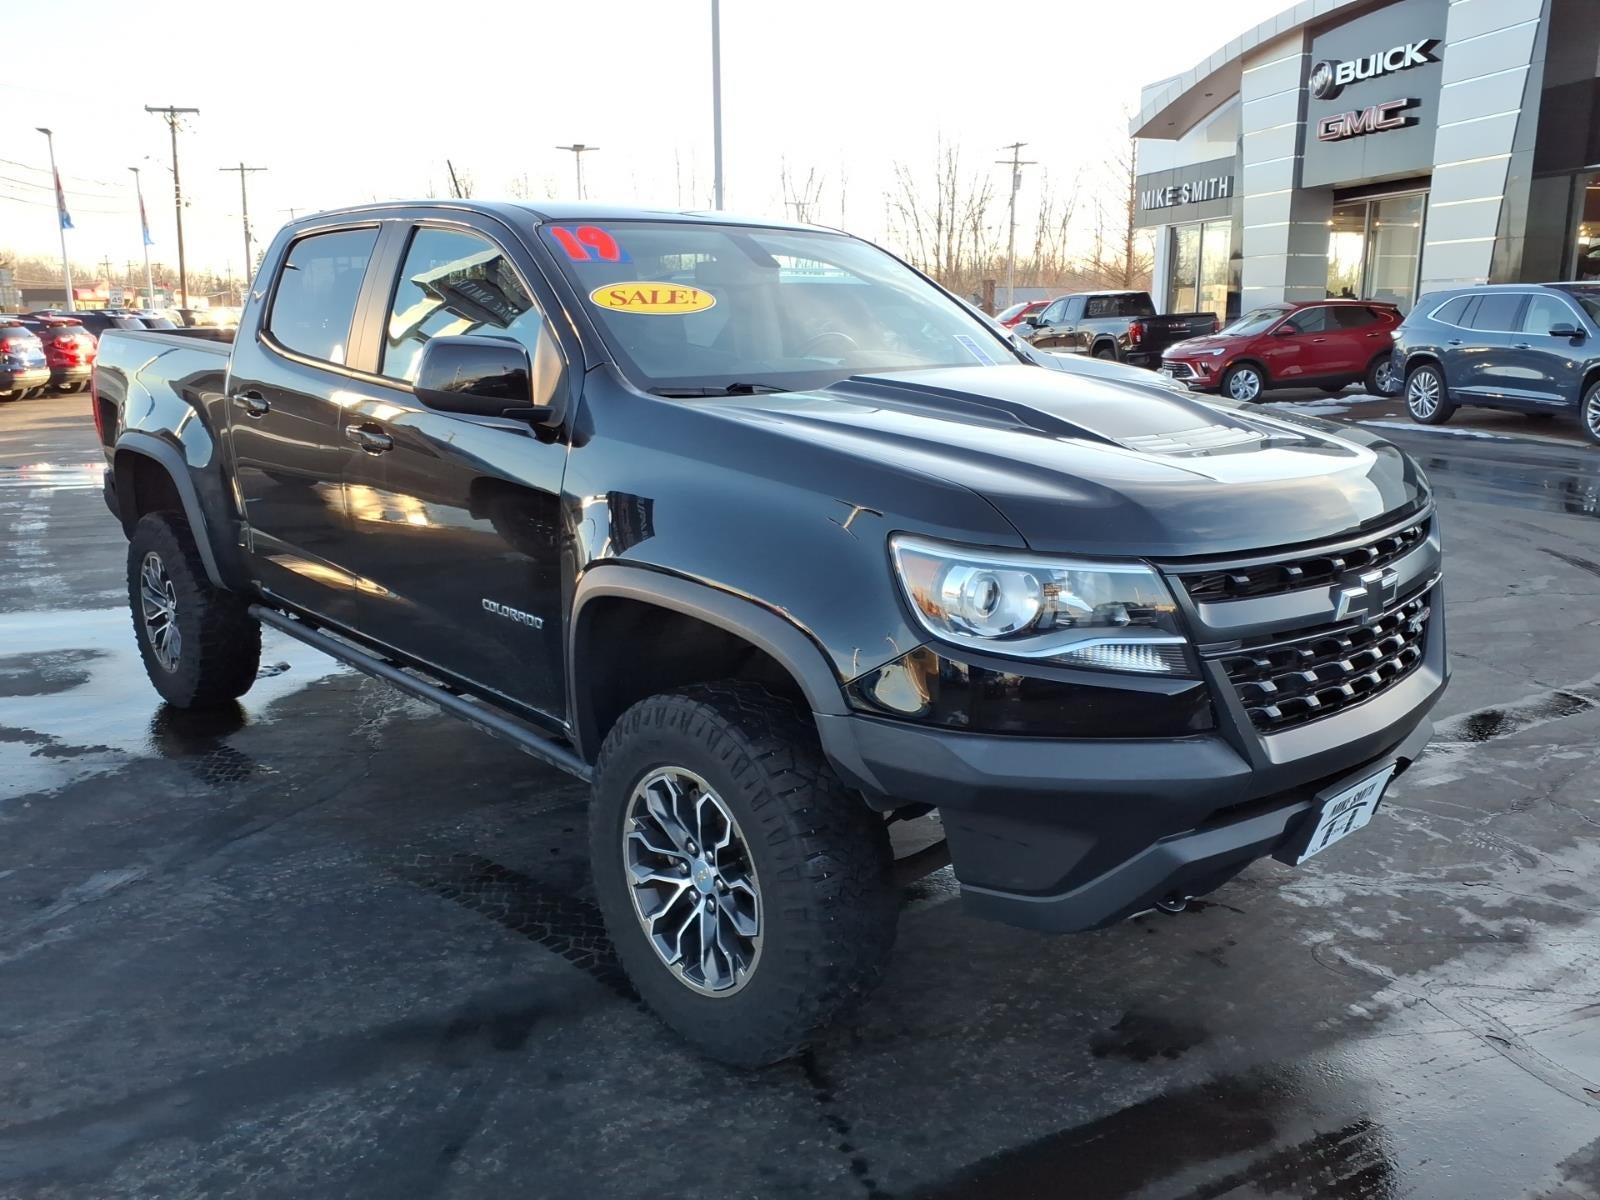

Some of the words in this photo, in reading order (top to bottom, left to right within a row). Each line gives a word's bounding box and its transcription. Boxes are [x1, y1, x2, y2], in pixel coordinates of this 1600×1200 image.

[1335, 39, 1430, 86] BUICK
[1317, 98, 1408, 141] GMC
[1140, 186, 1173, 210] MIKE
[1182, 175, 1229, 204] SMITH
[551, 225, 620, 262] 19
[609, 289, 700, 307] SALE!
[481, 598, 543, 629] COLORADO
